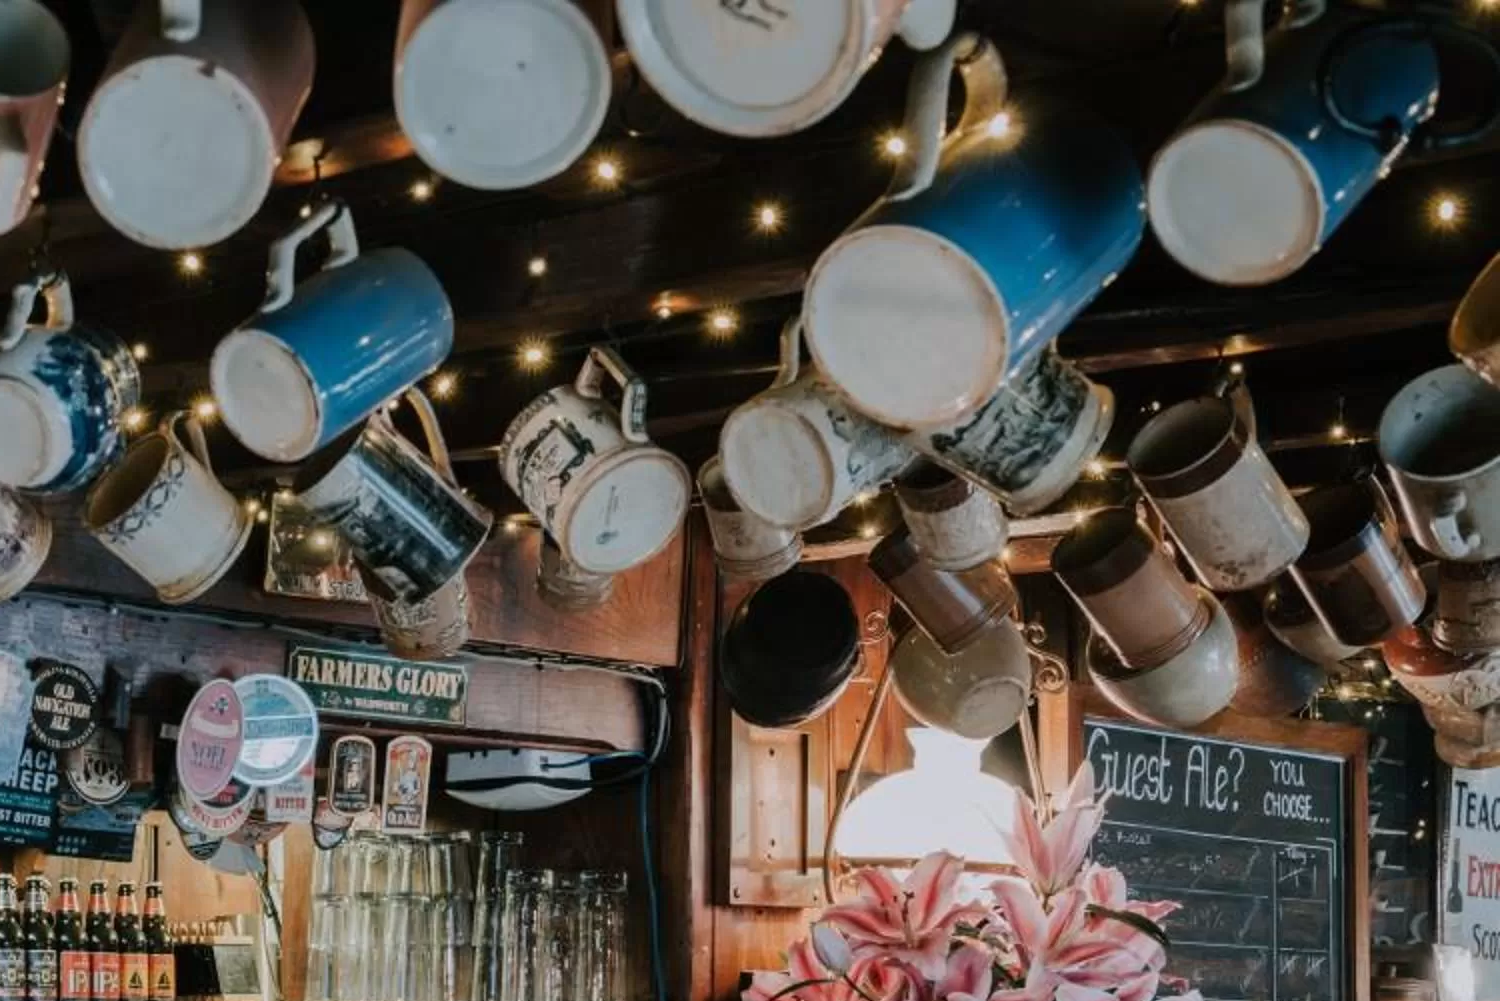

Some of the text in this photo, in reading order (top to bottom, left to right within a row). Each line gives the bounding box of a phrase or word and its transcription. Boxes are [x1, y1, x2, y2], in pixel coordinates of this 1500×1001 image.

[297, 654, 463, 700] FARMERS GLORY
[53, 683, 75, 699] OLD
[50, 716, 71, 732] ALE
[1087, 726, 1246, 813] Guest Ale?
[1269, 758, 1305, 788] YOU
[13, 810, 51, 828] BITTER
